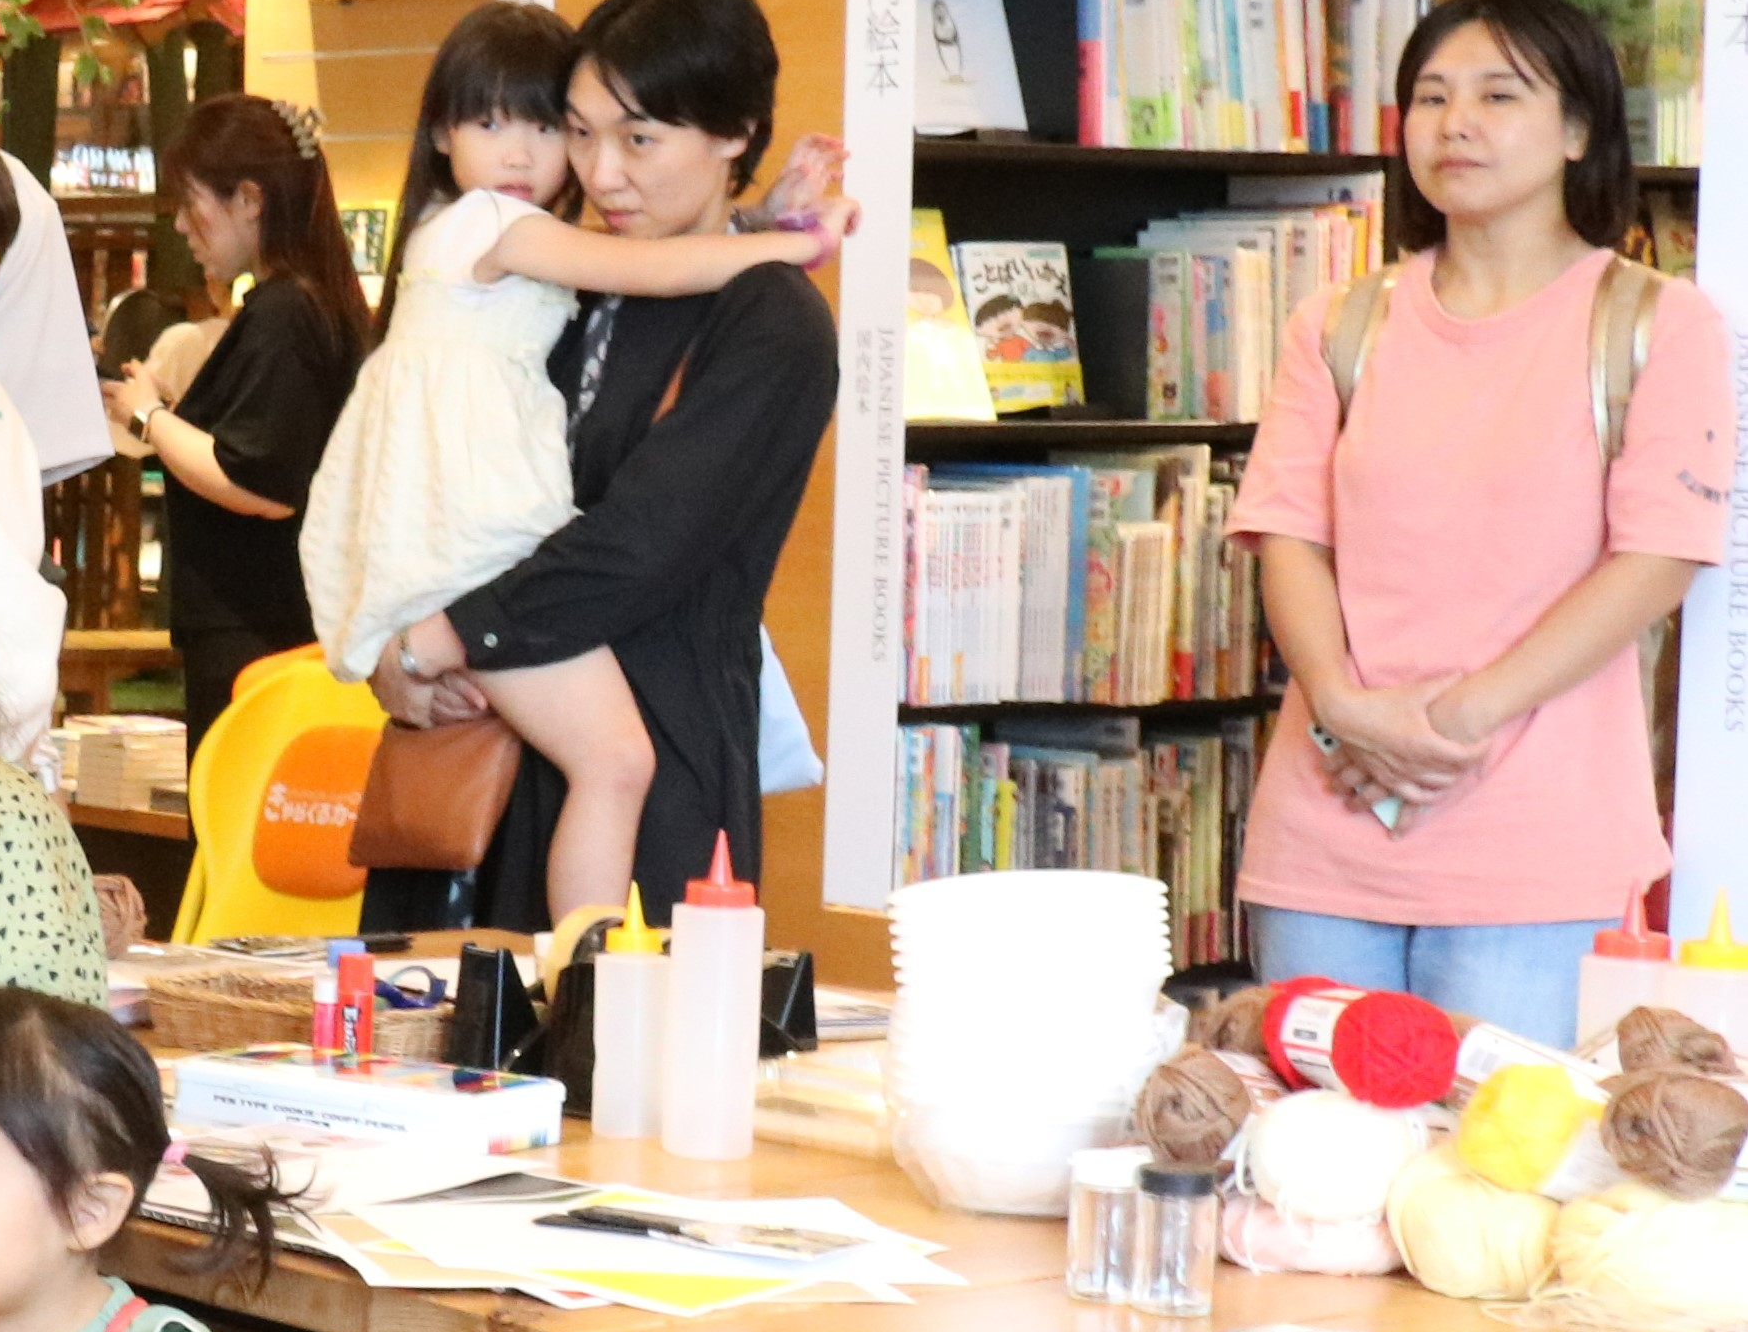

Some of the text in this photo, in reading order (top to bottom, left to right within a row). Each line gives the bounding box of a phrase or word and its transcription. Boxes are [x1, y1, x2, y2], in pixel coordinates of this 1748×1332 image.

[871, 326, 895, 664] JAPANESE PICTURE BOOKS
[1723, 629, 1748, 734] BOOKS
